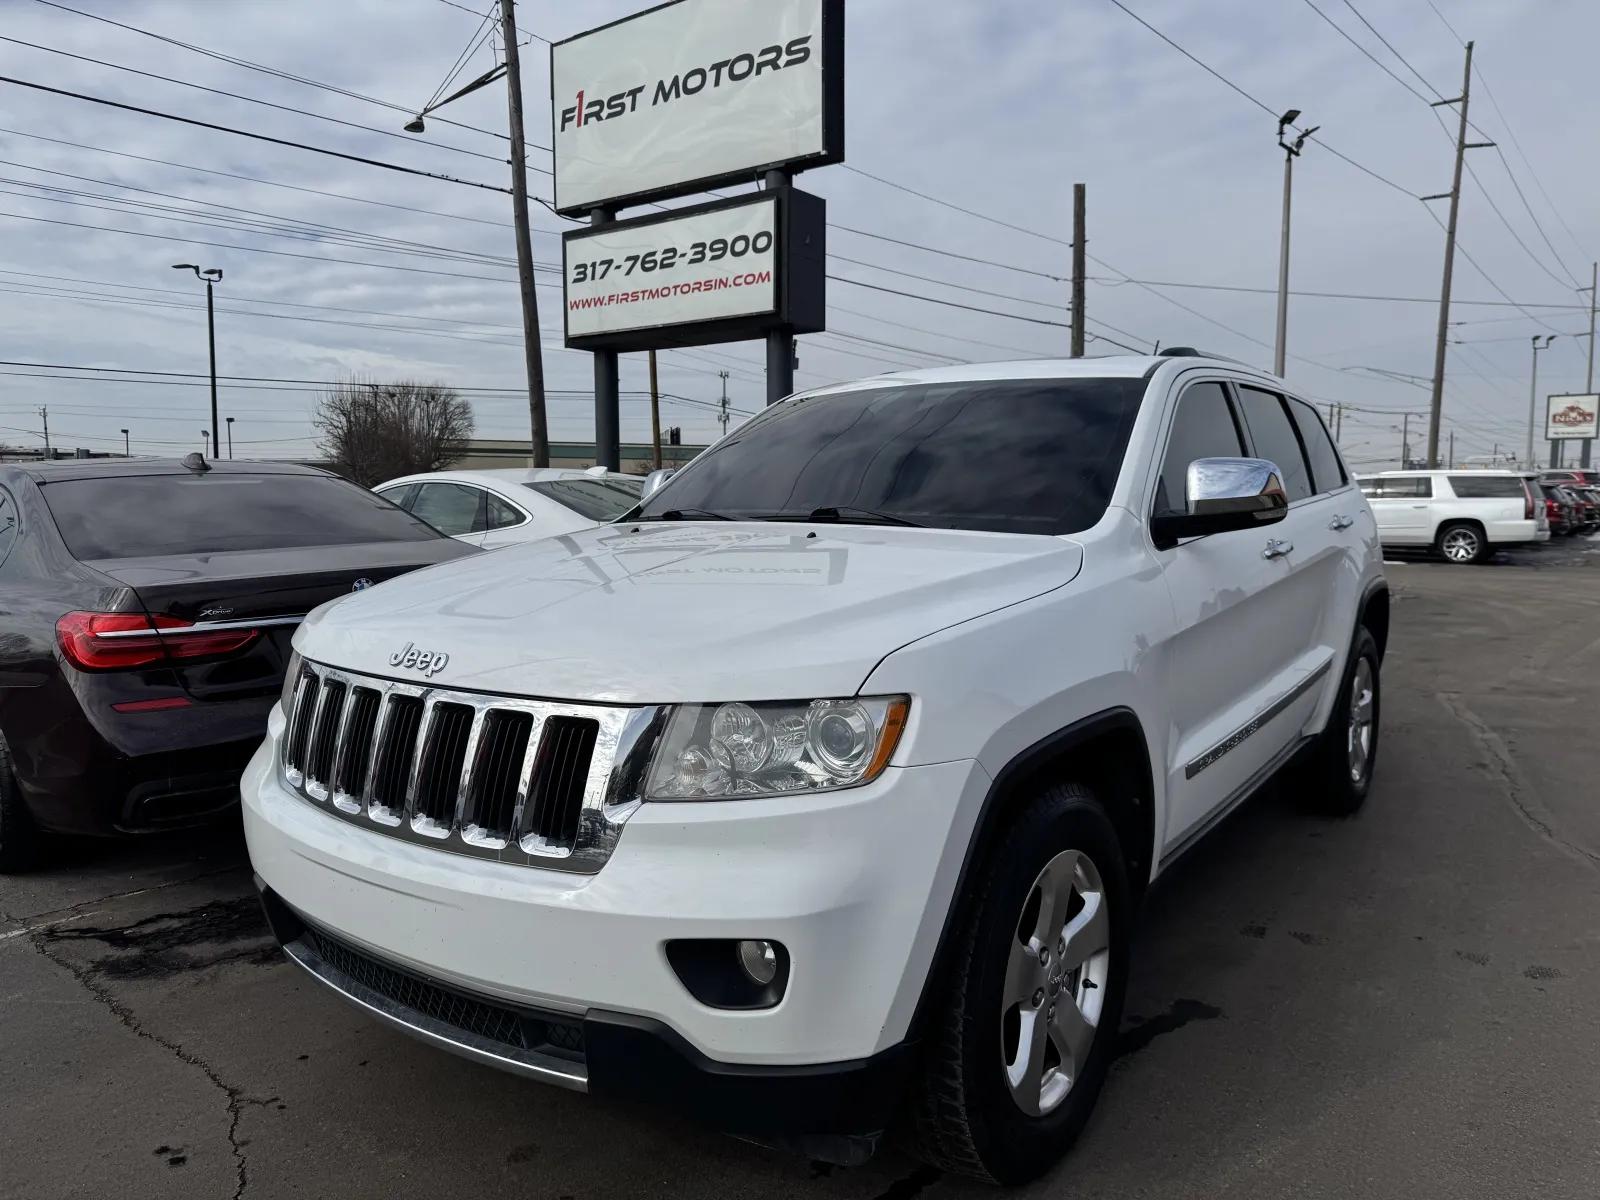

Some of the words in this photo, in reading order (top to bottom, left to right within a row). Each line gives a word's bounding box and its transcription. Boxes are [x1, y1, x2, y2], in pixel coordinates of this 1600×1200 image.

[652, 35, 813, 107] MOTORS
[571, 230, 773, 284] 317-762-3900
[569, 270, 771, 311] WWW.FIRSTMOTORSIN.COM
[389, 642, 450, 678] Jeep
